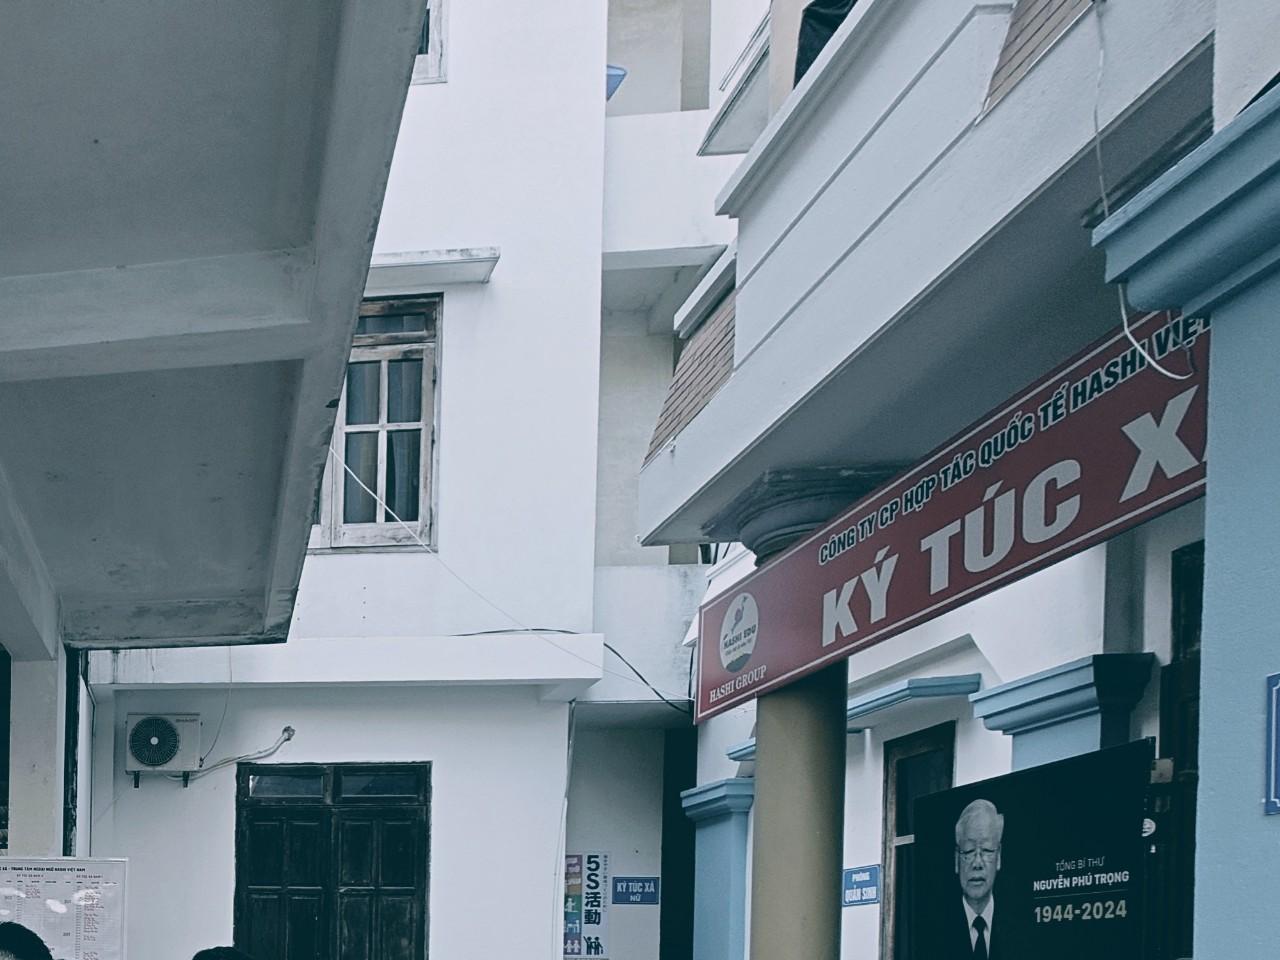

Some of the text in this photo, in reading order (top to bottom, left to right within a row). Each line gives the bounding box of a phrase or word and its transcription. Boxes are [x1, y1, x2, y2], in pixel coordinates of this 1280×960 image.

[819, 526, 857, 566] CÔNG
[858, 511, 877, 543] TY
[878, 497, 901, 529] CP
[902, 475, 937, 516] HỢP
[939, 452, 976, 492] TÁC
[979, 410, 1035, 468] QUỐC
[1037, 380, 1070, 431] TẾ
[1070, 338, 1149, 413] HASHI
[822, 545, 899, 648] KÝ
[920, 459, 1081, 596] TÚC
[709, 664, 767, 703] HASHI GROUP
[1033, 870, 1130, 892] NGUYỄN PHÚ TRỌNG
[1087, 856, 1105, 868] THƯ
[583, 854, 602, 926] 5S活動
[1034, 899, 1128, 923] 1944-2024
